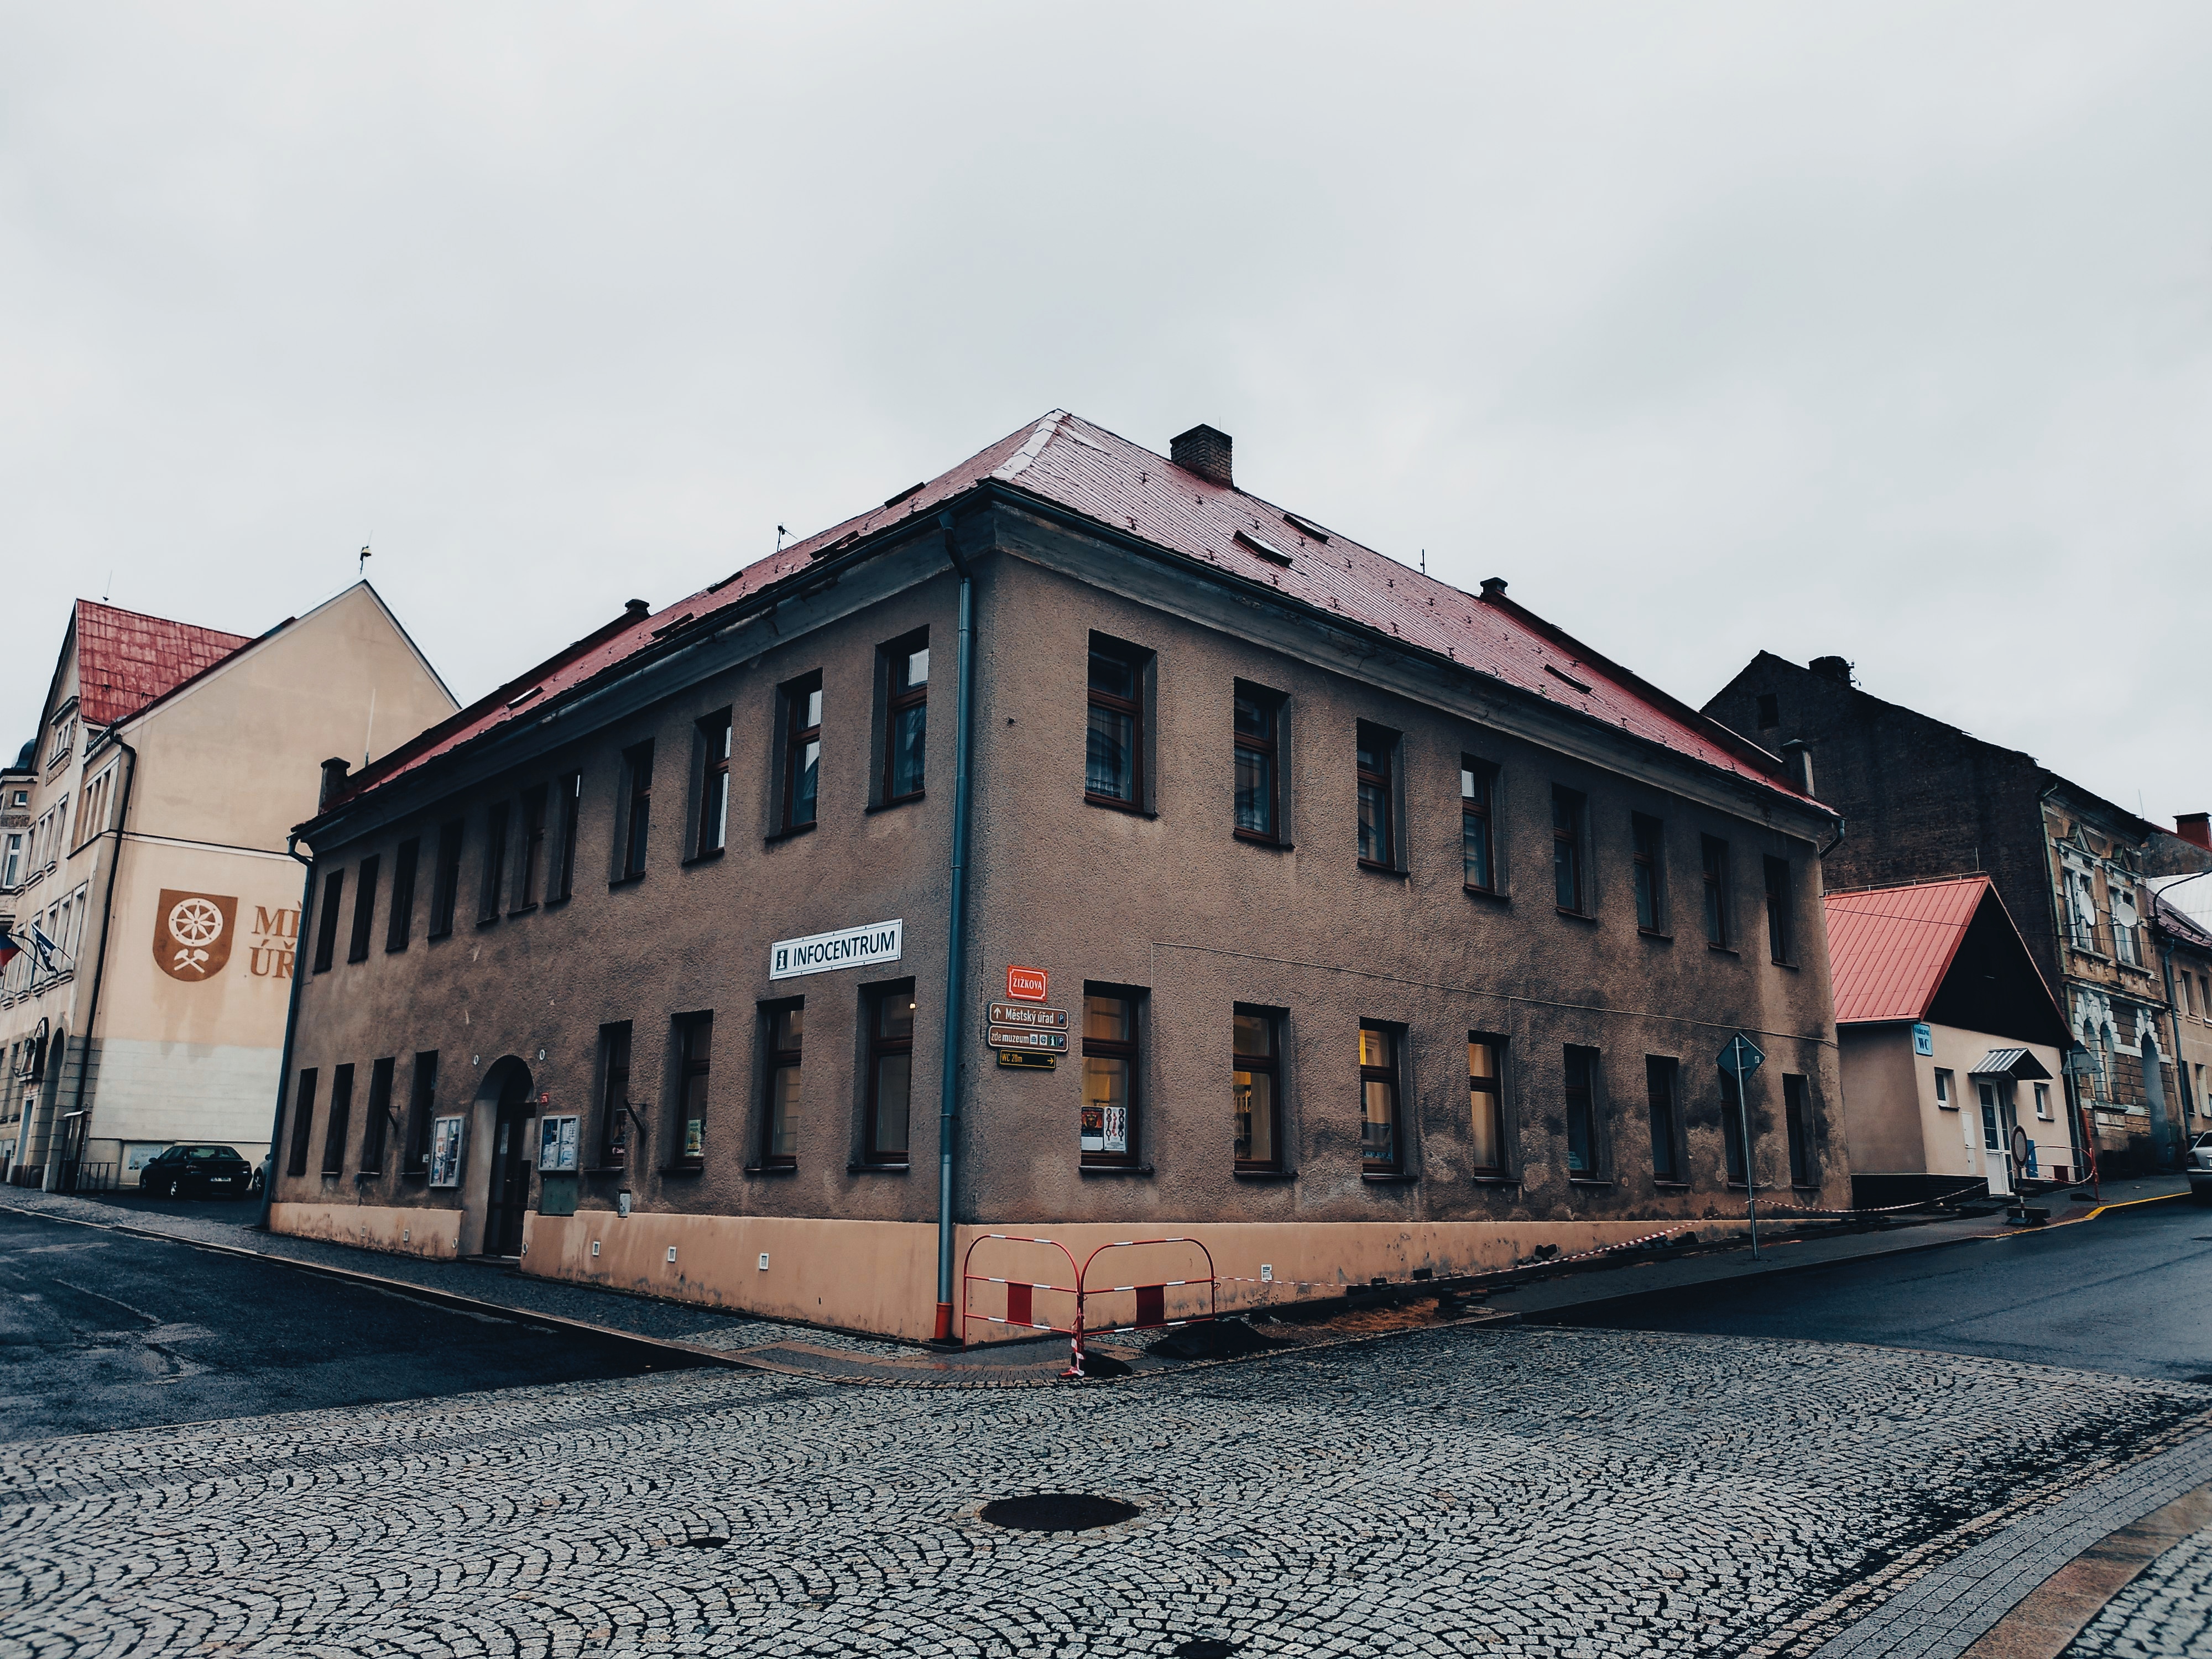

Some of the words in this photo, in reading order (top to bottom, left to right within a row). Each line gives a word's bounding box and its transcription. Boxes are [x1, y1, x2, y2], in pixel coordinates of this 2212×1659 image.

[793, 930, 895, 967] INFOCENTRUM
[1013, 975, 1042, 990] ŽIŽKOVA
[1005, 1008, 1036, 1025] Městský
[1037, 1011, 1054, 1024] úřad
[991, 1031, 1001, 1041] zde
[1002, 1034, 1029, 1044] muzeum
[1918, 1037, 1929, 1050] WC
[1002, 1053, 1010, 1061] WC
[1011, 1054, 1022, 1062] 20m
